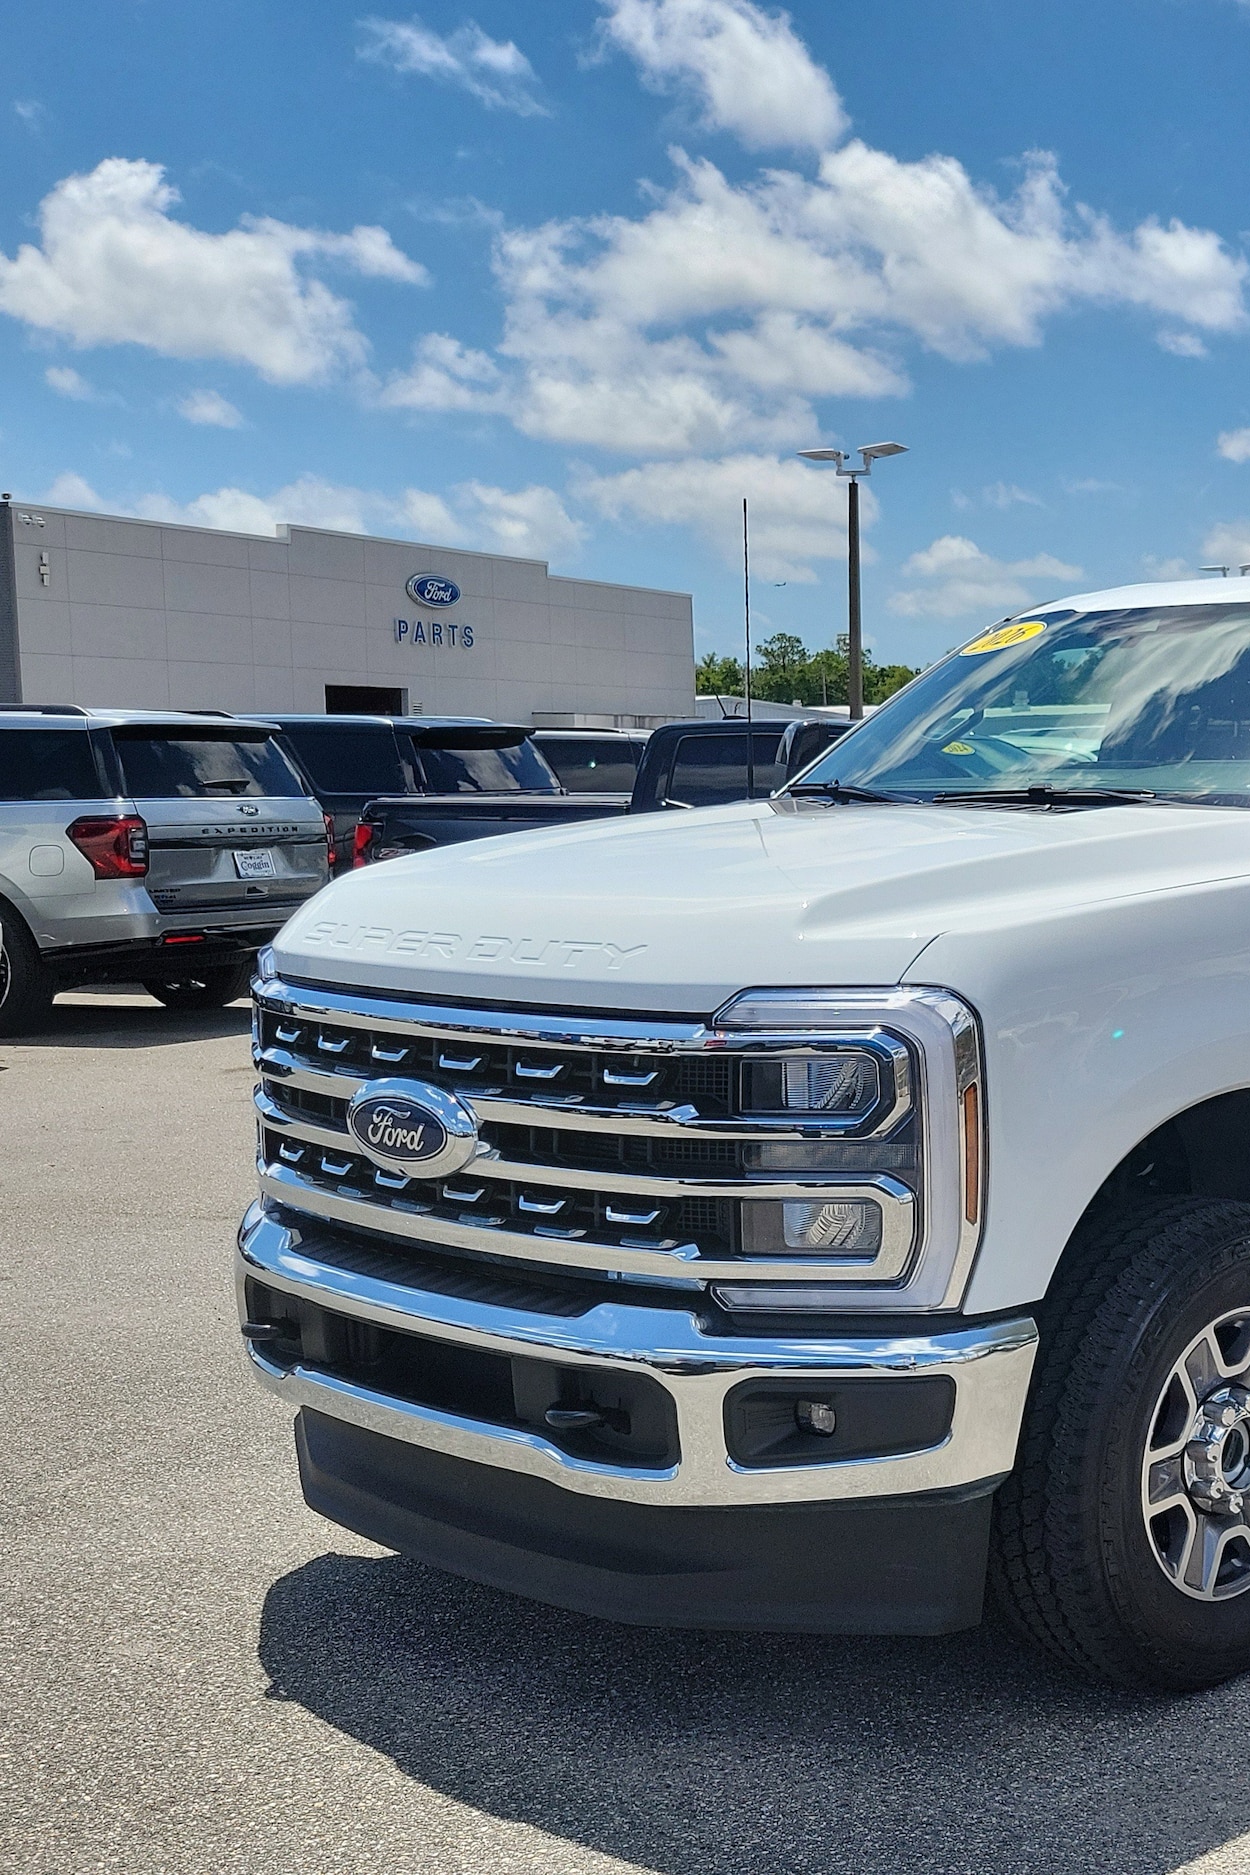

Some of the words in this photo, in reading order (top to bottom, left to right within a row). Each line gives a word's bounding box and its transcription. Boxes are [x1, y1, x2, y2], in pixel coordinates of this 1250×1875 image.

[424, 581, 452, 602] Ford
[396, 619, 474, 648] PARTS
[202, 826, 299, 834] EXPEDITION
[241, 860, 270, 872] Coggin
[303, 921, 463, 958] SUPER
[467, 937, 648, 969] DUTY
[367, 1104, 424, 1152] Ford
